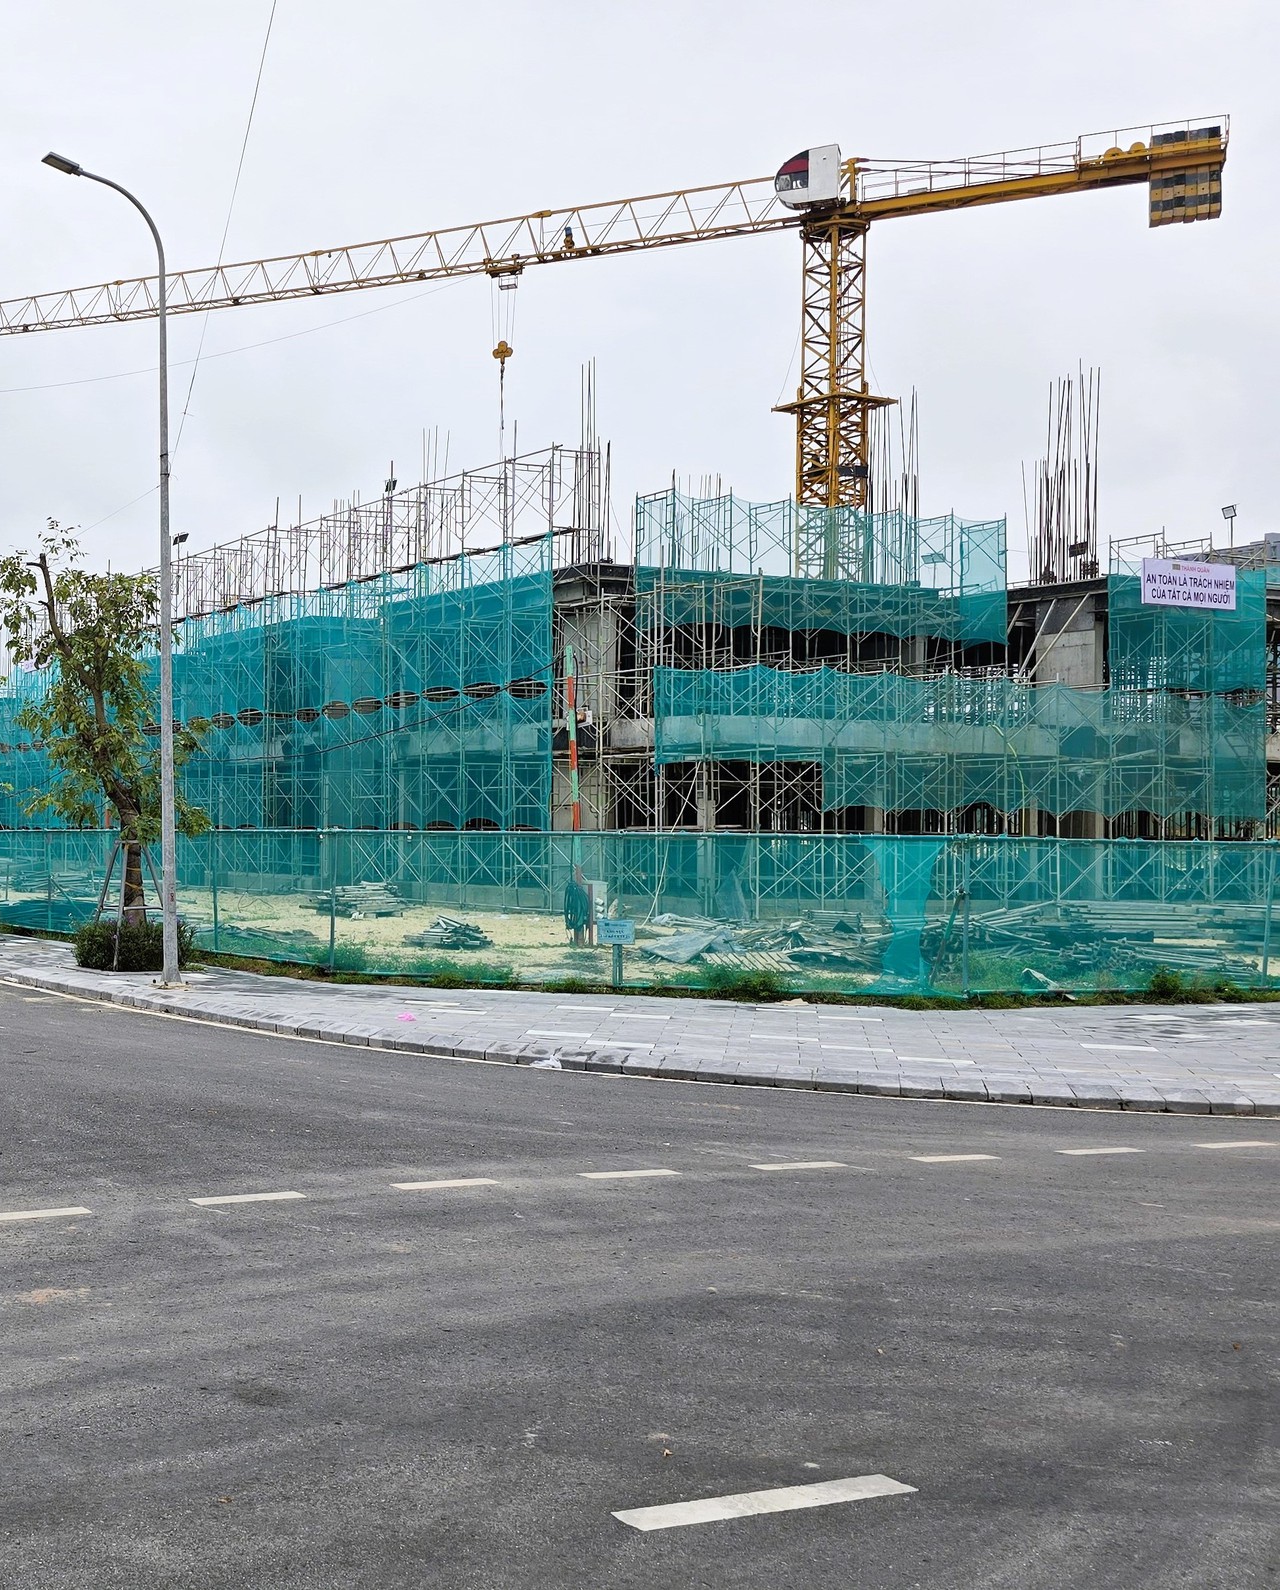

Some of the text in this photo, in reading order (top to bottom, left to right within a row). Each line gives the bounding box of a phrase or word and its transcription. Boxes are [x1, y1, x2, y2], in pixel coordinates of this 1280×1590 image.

[1146, 573, 1234, 592] AN TOÀN LÀ TRÁCH NHIỆM
[1152, 586, 1230, 605] CỦA TẤT CẢ MỌI NGƯỜI
